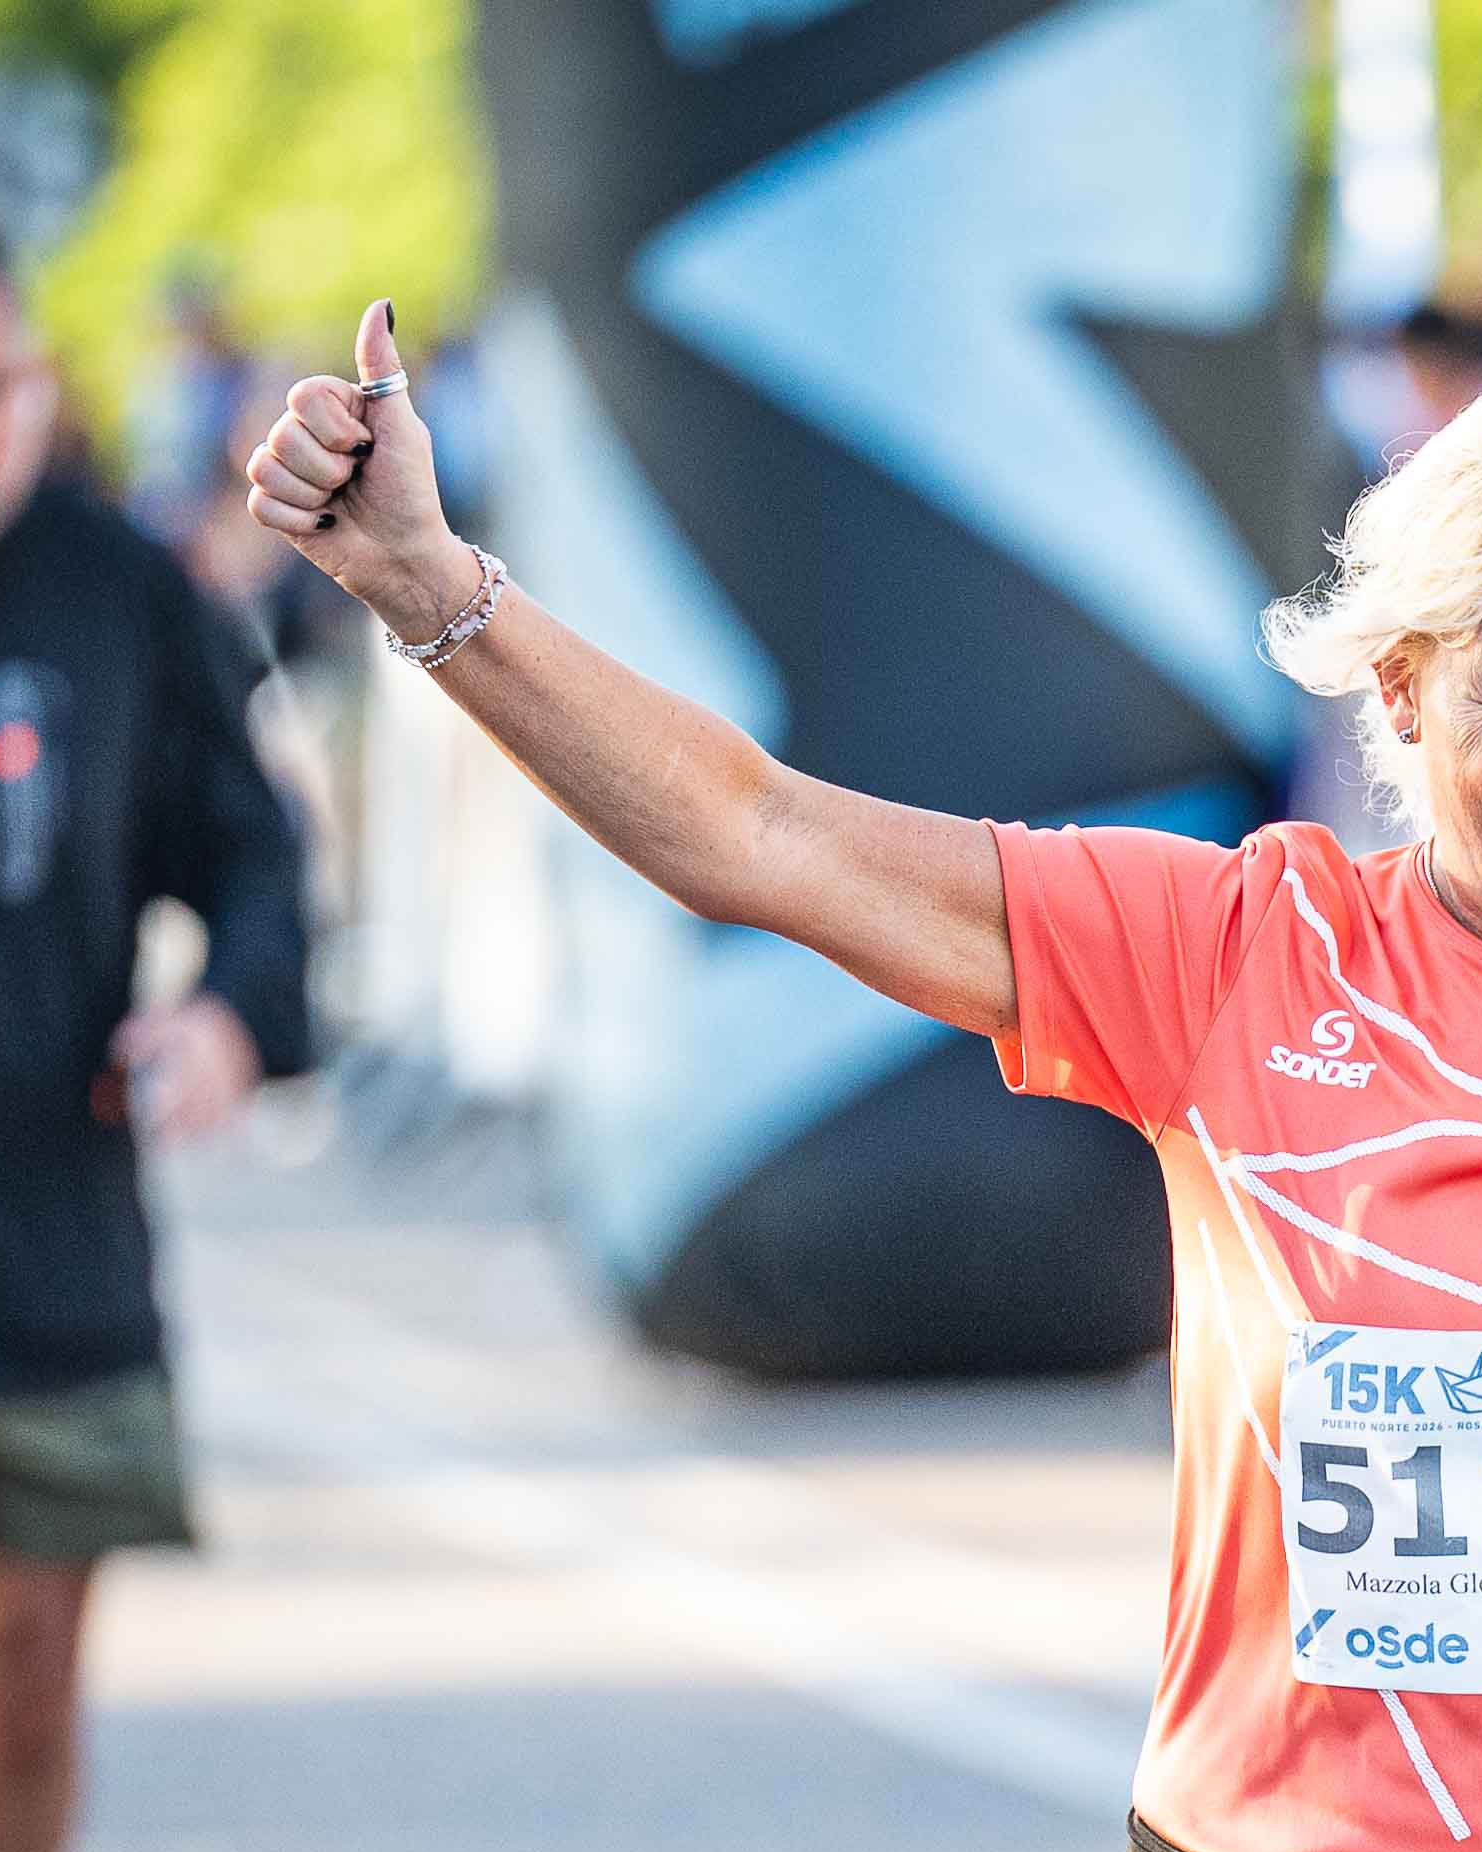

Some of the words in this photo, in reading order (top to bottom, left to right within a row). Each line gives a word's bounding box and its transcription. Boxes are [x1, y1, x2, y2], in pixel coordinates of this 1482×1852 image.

[1323, 1361, 1426, 1415] 15K
[1321, 1418, 1366, 1431] PUERTO
[1370, 1421, 1410, 1433] NORTE
[1414, 1421, 1443, 1433] 2026
[1346, 1570, 1442, 1595] Mazzola
[1345, 1622, 1469, 1665] osde
